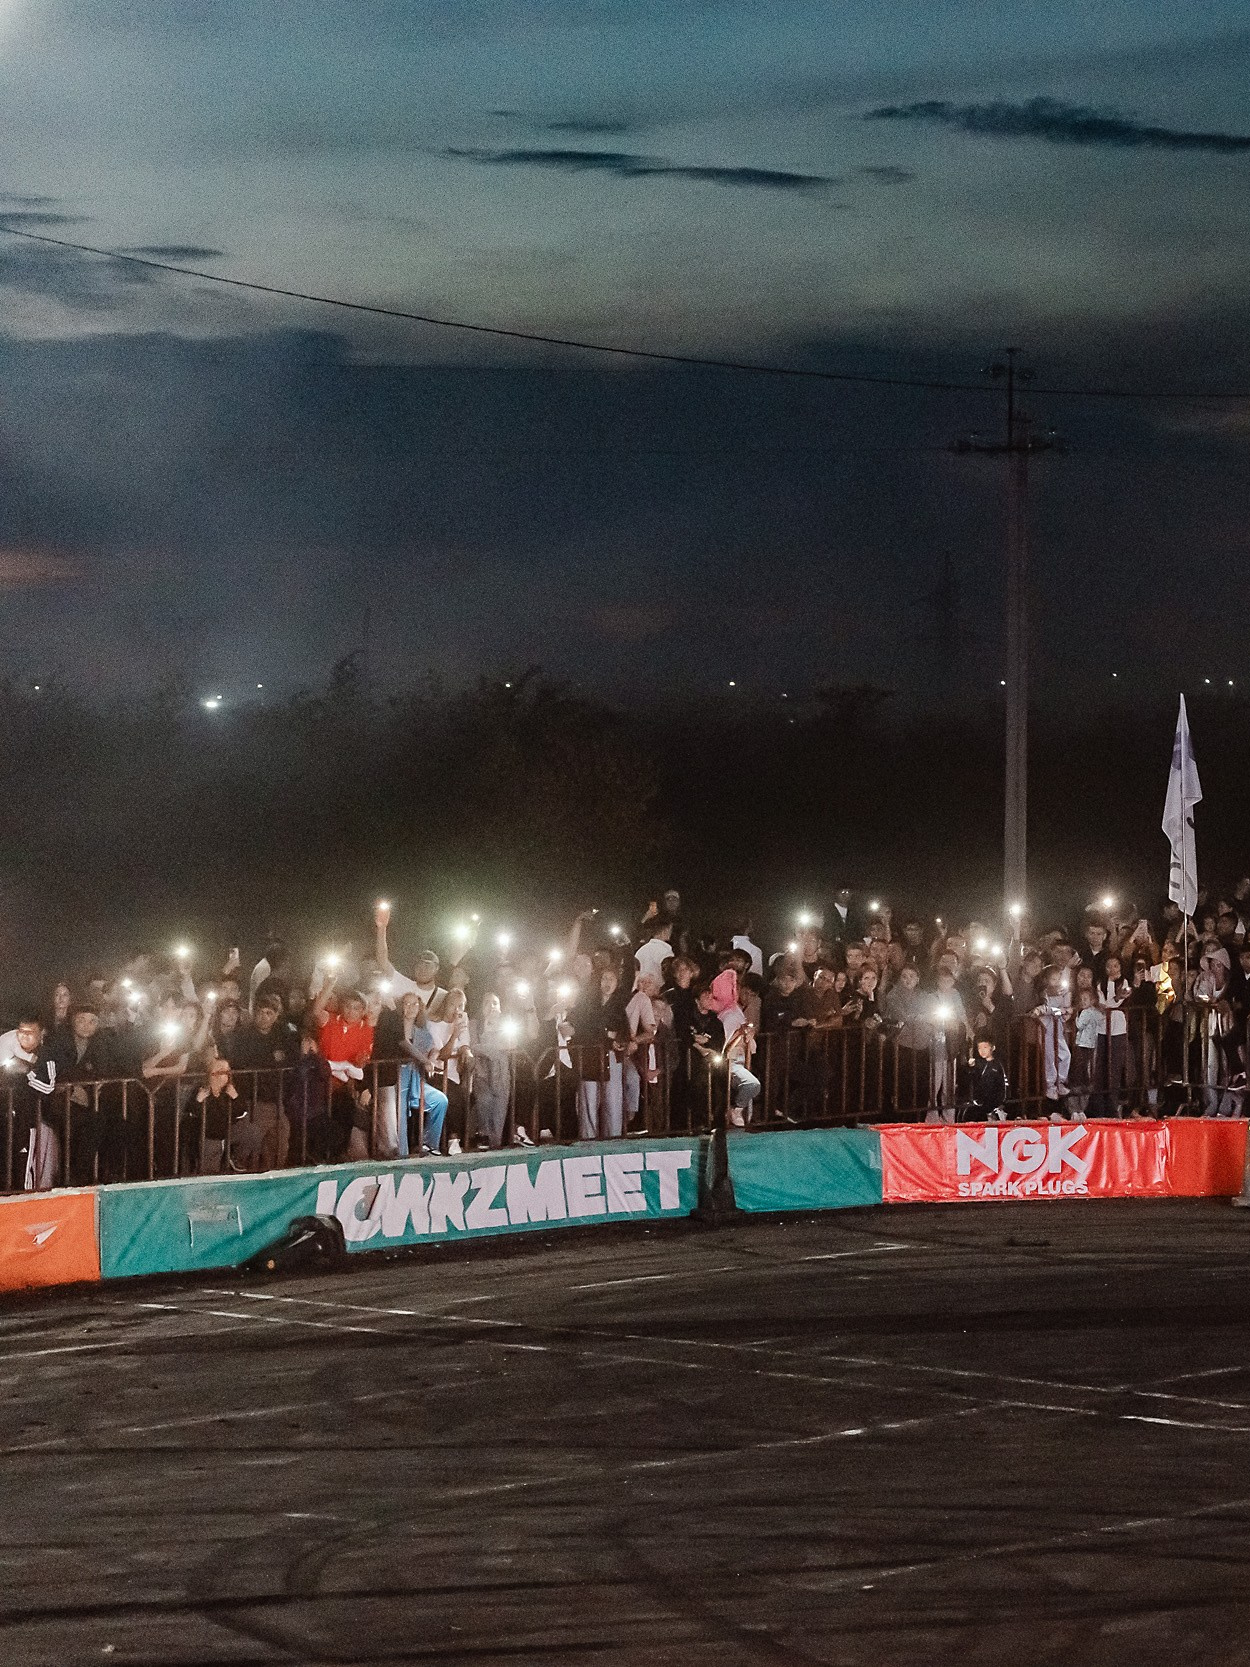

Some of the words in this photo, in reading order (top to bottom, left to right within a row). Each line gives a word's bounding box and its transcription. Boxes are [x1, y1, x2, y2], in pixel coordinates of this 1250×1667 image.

[957, 1124, 1088, 1176] NGK
[958, 1181, 1021, 1197] SPARK
[1024, 1179, 1089, 1195] PLUGS
